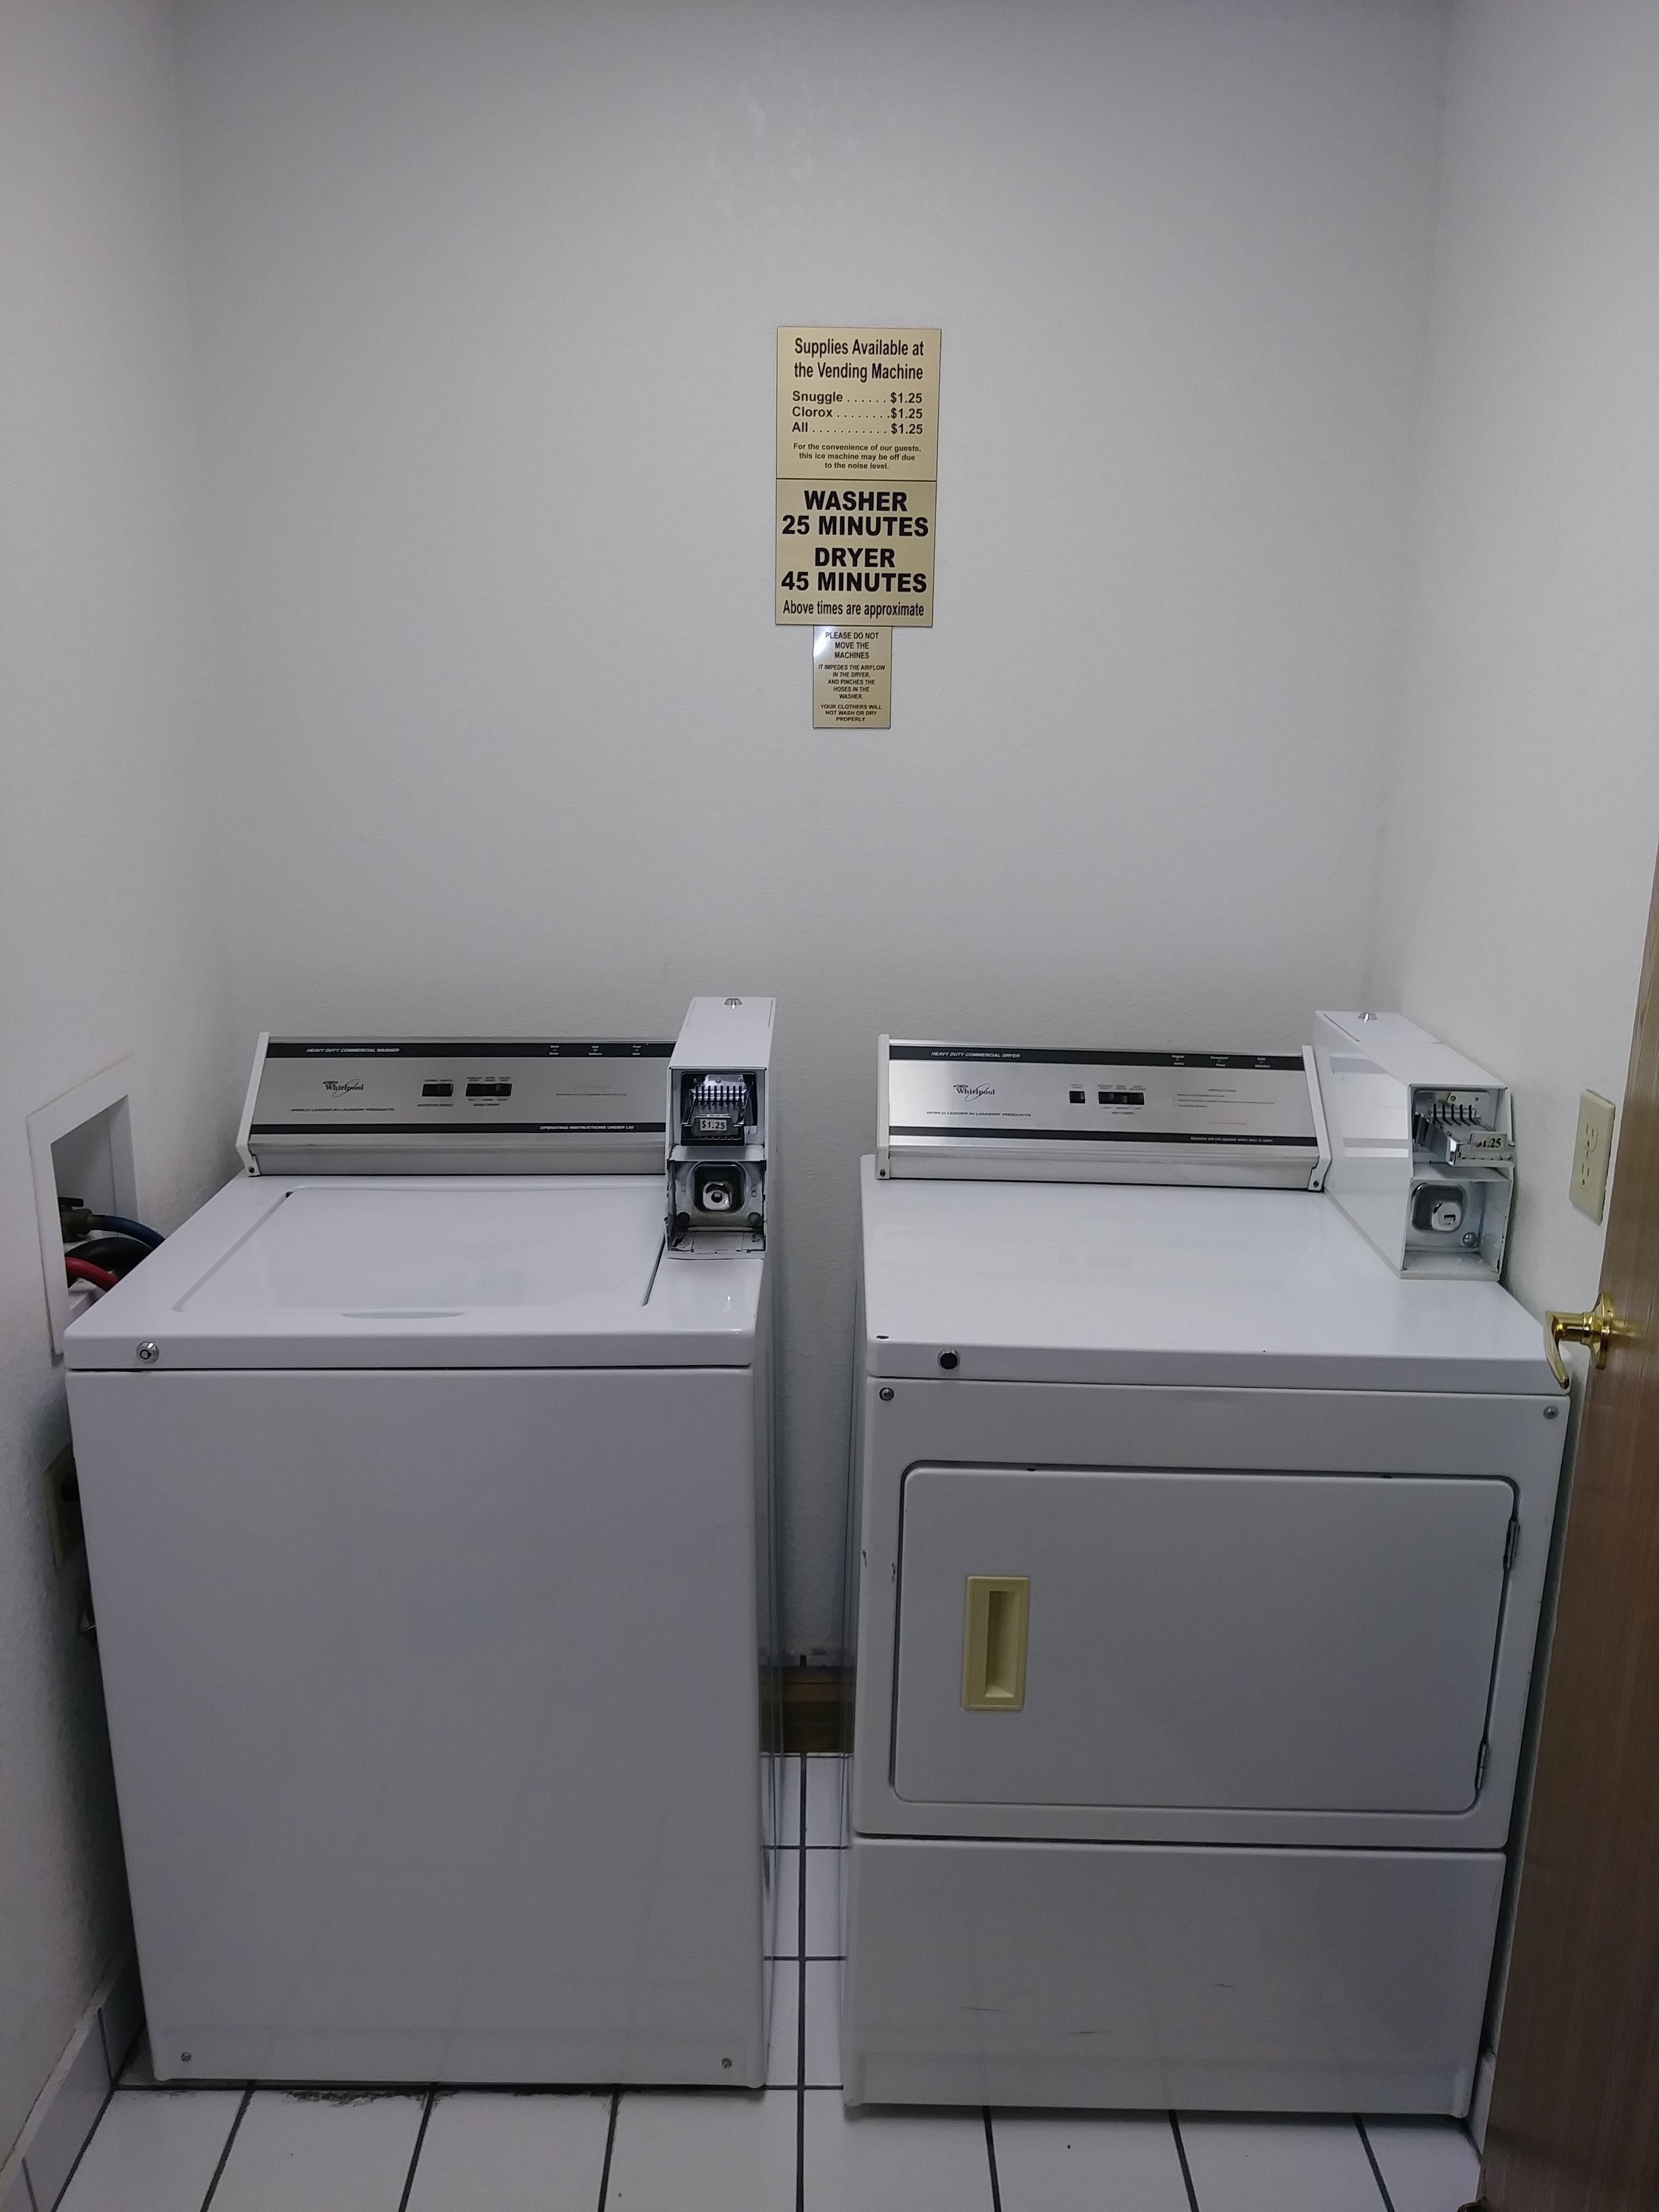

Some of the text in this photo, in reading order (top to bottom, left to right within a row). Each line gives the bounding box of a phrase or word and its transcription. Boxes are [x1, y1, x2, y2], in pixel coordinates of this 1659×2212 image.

[796, 338, 923, 358] Supplies Available at
[794, 362, 923, 382] the Vending Machine
[793, 391, 922, 404] Snuggle $1.25
[793, 406, 922, 419] Clorox $1.25
[792, 422, 923, 435] All $1.25
[804, 490, 907, 512] WASHER
[782, 515, 928, 537] 25 MINUTES
[815, 547, 895, 567] DRYER
[781, 571, 926, 593] 45 MINUTES
[783, 600, 924, 619] Above times are approximate
[325, 1084, 363, 1092] Whirlpool
[956, 1088, 995, 1096] Whirlpool
[702, 1120, 725, 1129] $1.25
